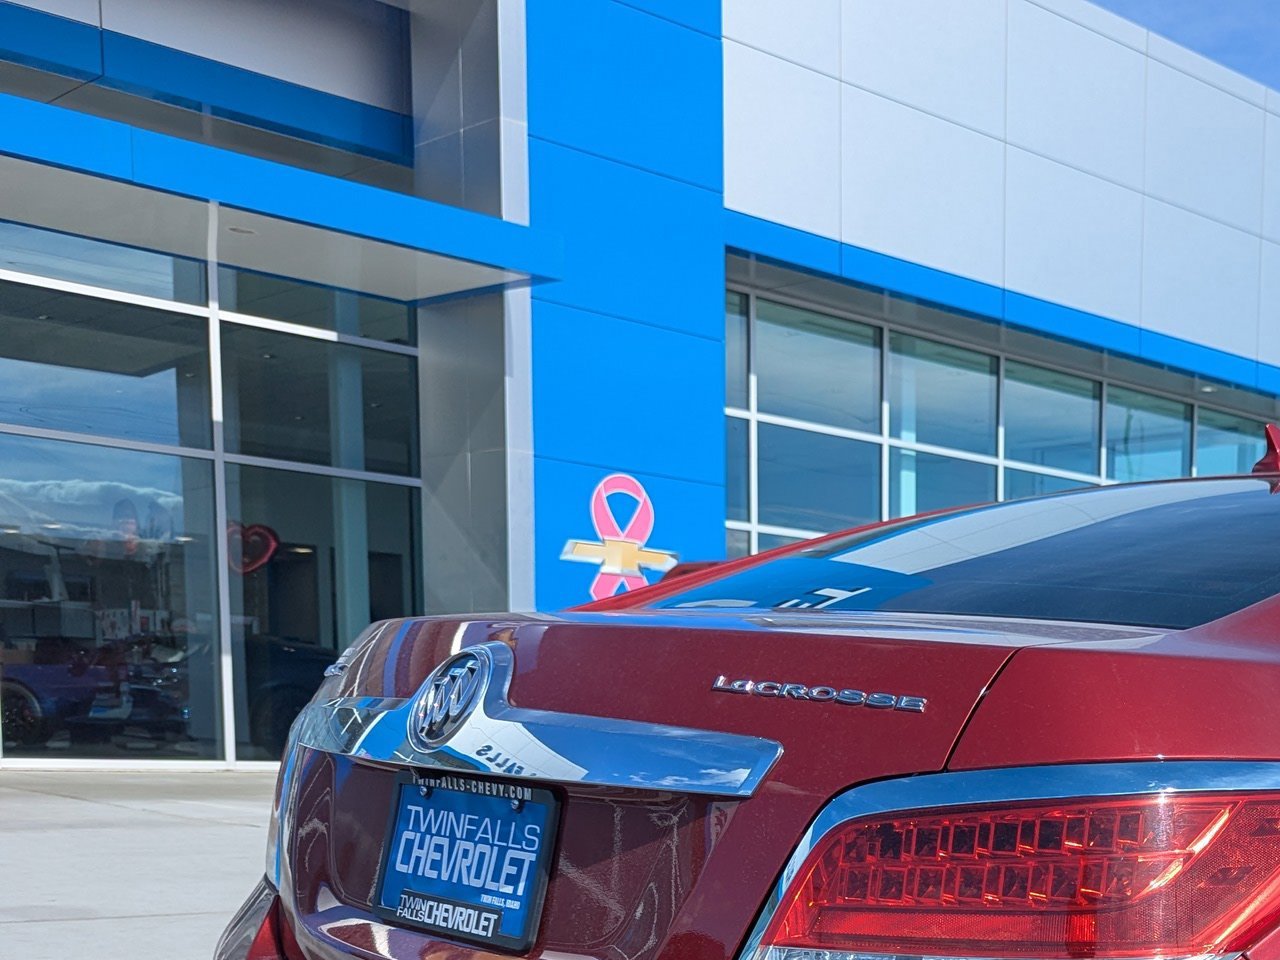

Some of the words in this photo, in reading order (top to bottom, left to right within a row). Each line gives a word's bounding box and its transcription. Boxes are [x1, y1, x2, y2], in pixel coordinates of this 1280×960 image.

[407, 804, 541, 851] TWINFALLS
[395, 831, 537, 896] CHEVROLET
[396, 906, 425, 922] FALLS
[400, 894, 427, 912] TWIN
[424, 900, 499, 938] CHEVROLET
